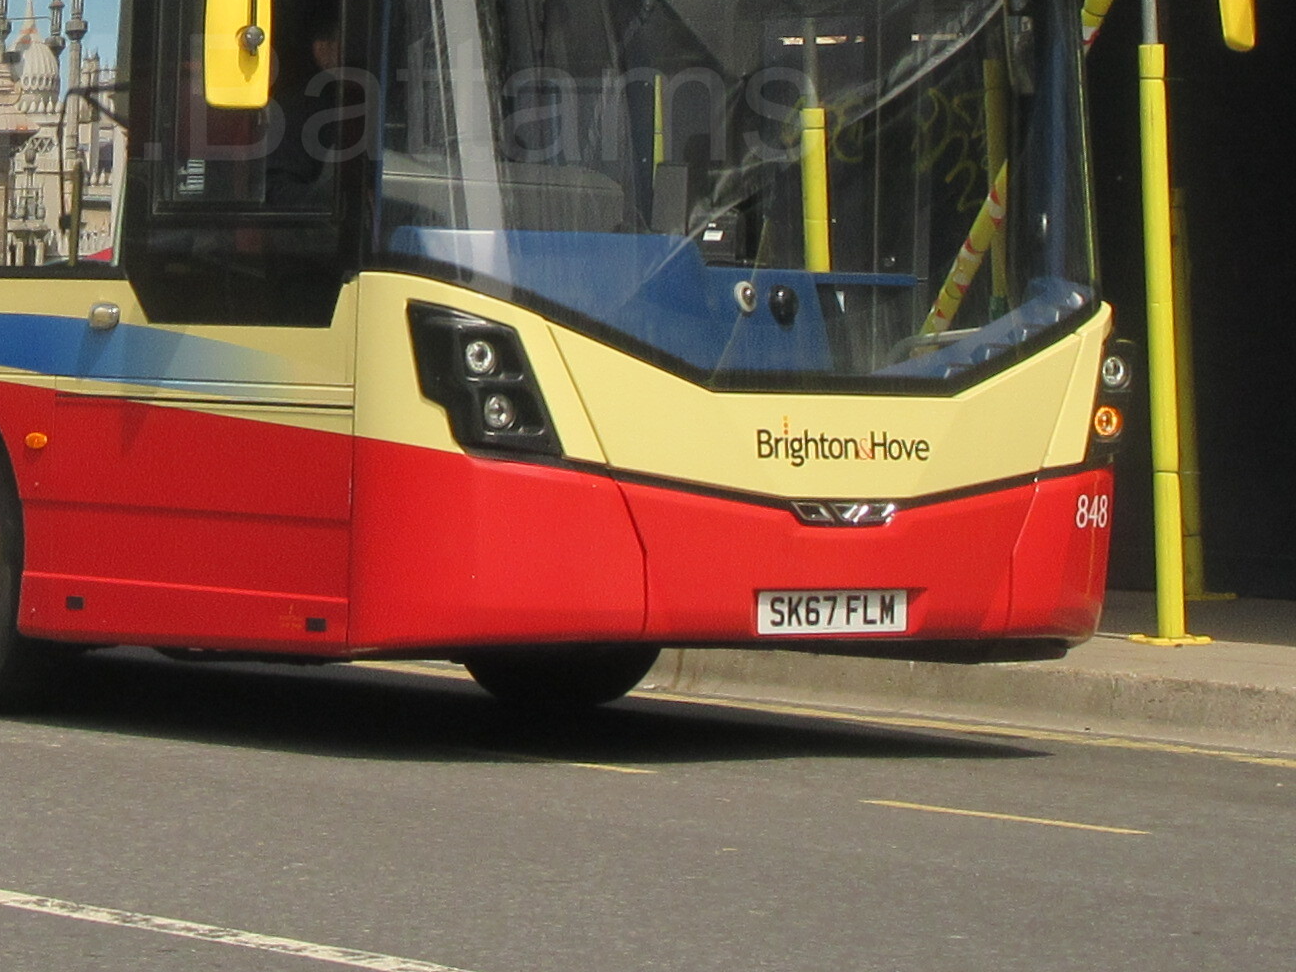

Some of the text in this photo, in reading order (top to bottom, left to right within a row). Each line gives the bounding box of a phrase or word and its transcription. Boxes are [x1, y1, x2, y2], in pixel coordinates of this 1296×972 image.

[1076, 494, 1108, 529] 848
[770, 594, 896, 627] SK67 FLM
